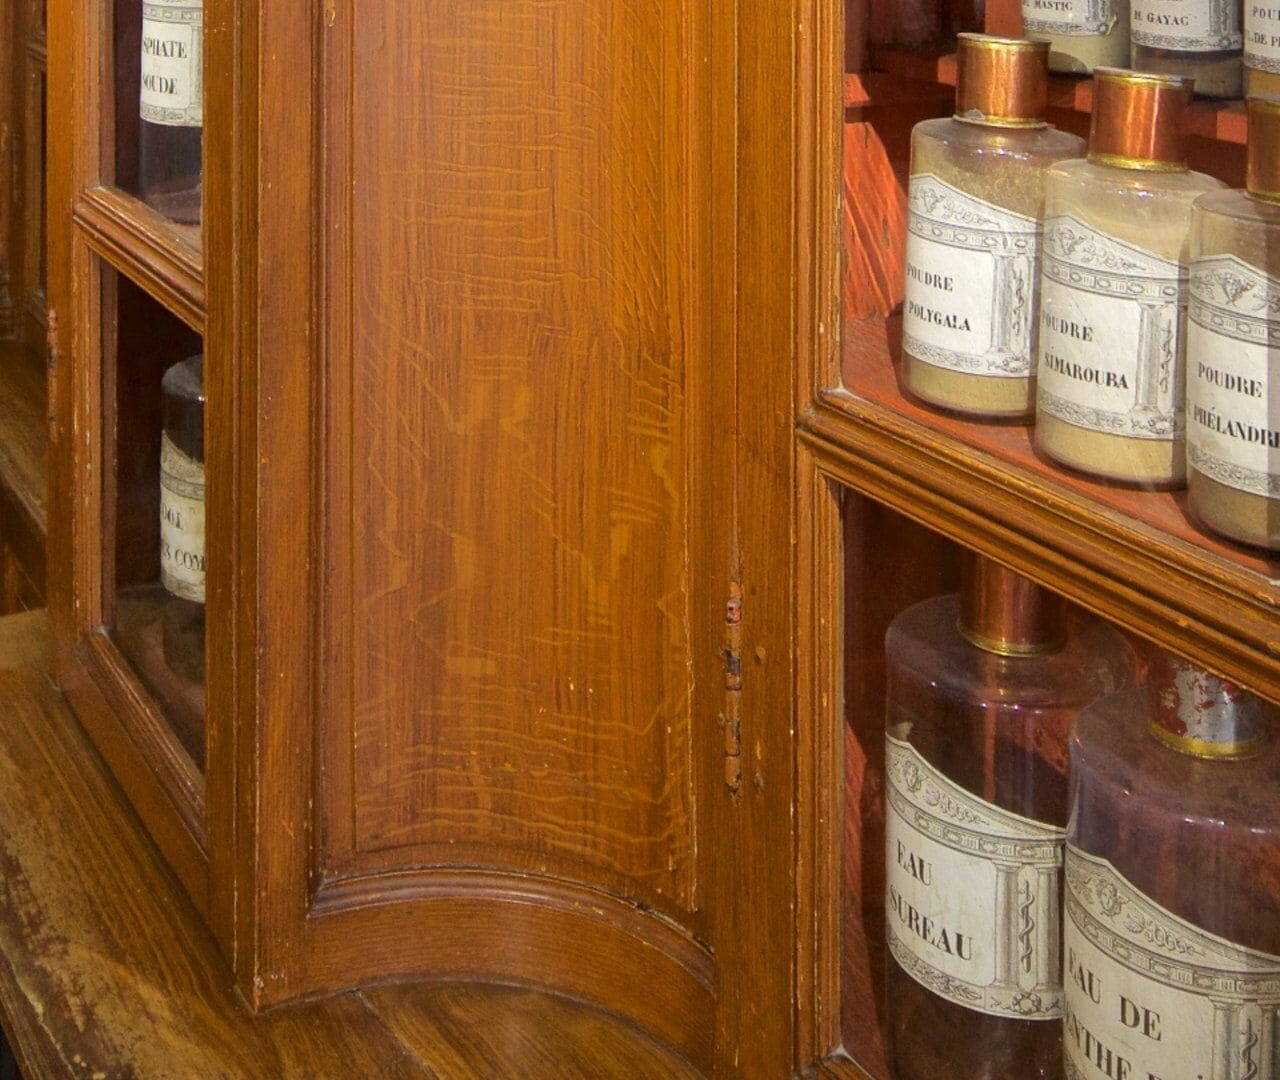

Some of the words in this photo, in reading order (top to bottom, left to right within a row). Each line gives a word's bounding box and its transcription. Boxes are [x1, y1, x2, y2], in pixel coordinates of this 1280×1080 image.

[1034, 0, 1073, 12] MASTIC
[1147, 12, 1190, 27] GAYAC
[908, 300, 972, 332] POLYGALA
[1044, 348, 1130, 390] SIMAROUBA
[1198, 361, 1263, 398] POUDRE
[897, 839, 933, 887] EAU
[889, 884, 974, 961] SUREAU
[1119, 994, 1162, 1042] DE
